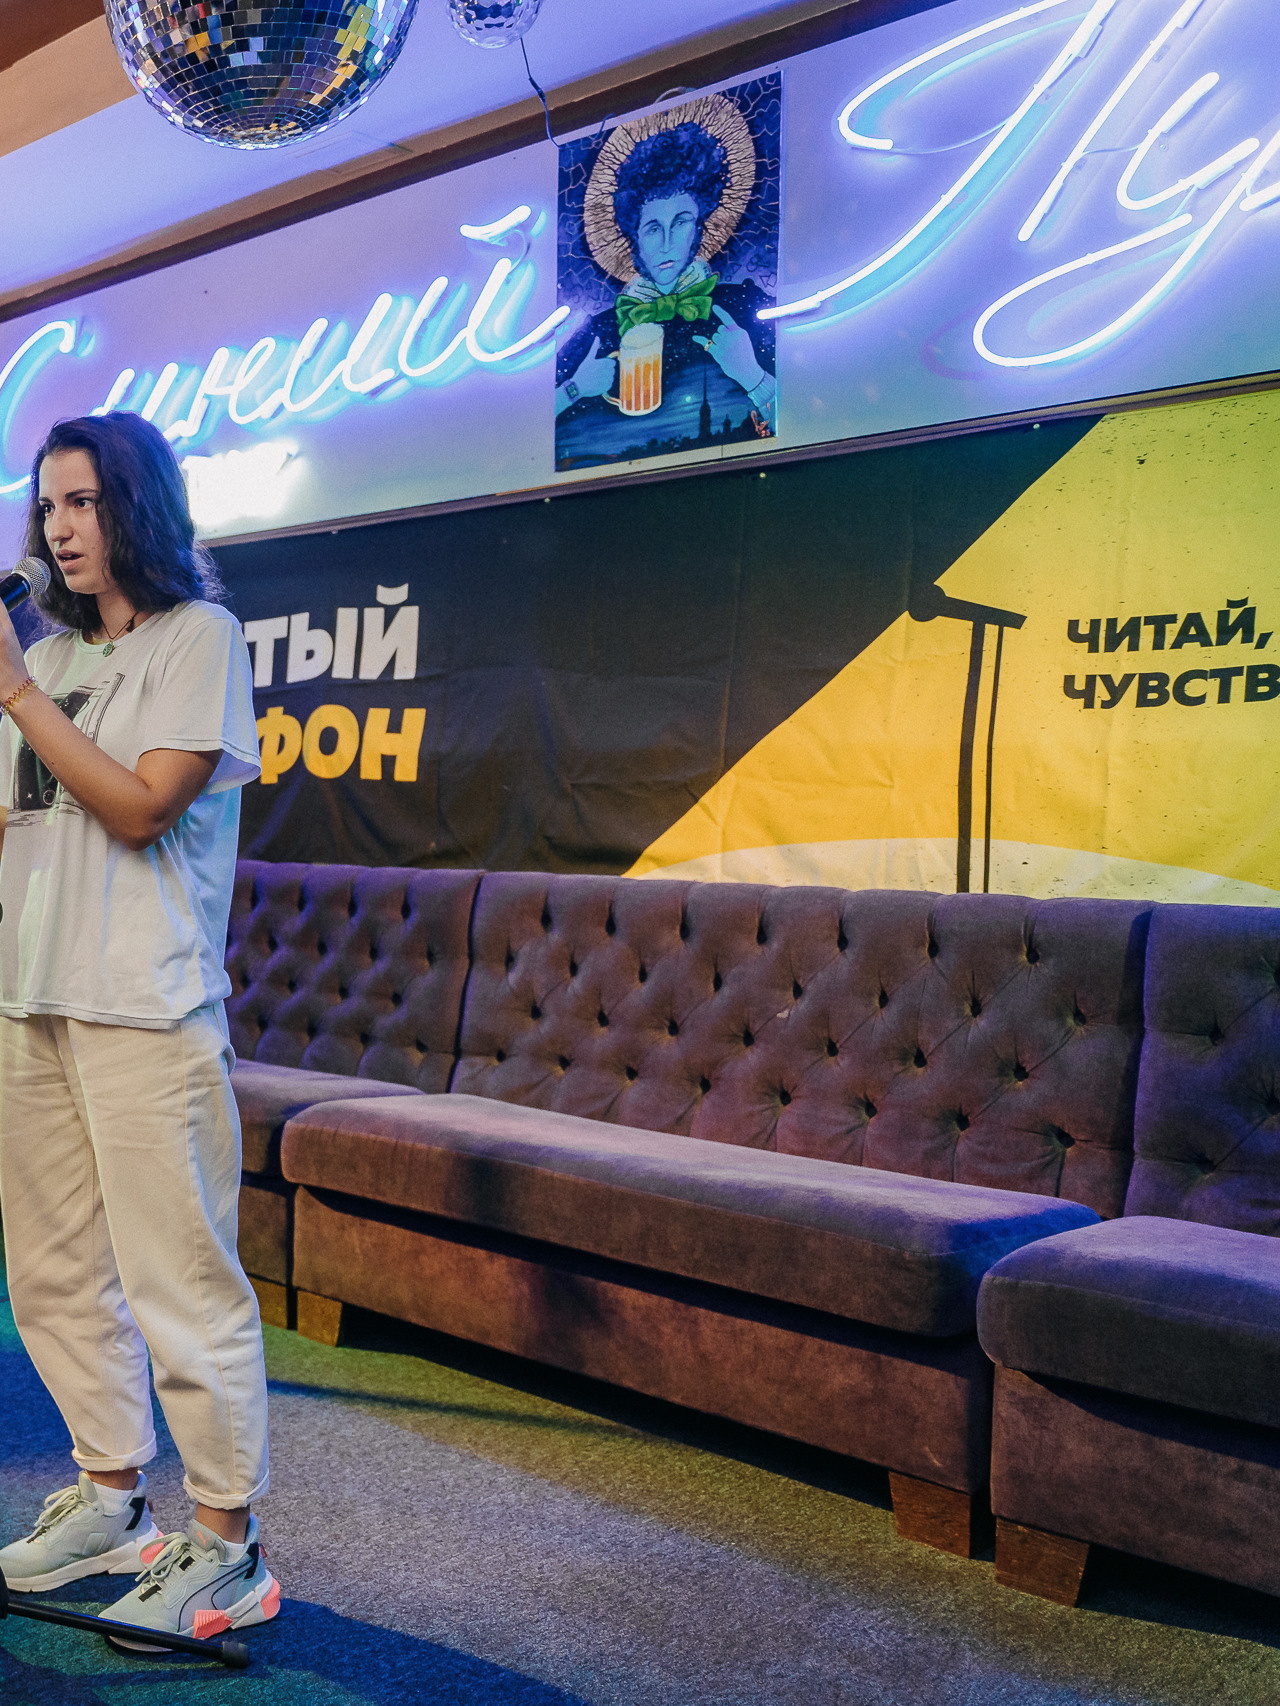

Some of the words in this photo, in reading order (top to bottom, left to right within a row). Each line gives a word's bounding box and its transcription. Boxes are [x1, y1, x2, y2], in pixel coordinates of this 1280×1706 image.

[756, 0, 1280, 367] Пу
[240, 583, 420, 688] ТЫЙ
[1067, 596, 1274, 653] ЧИТАЙ,
[1063, 664, 1280, 709] ЧУВСТВ
[256, 704, 426, 784] ФОН
